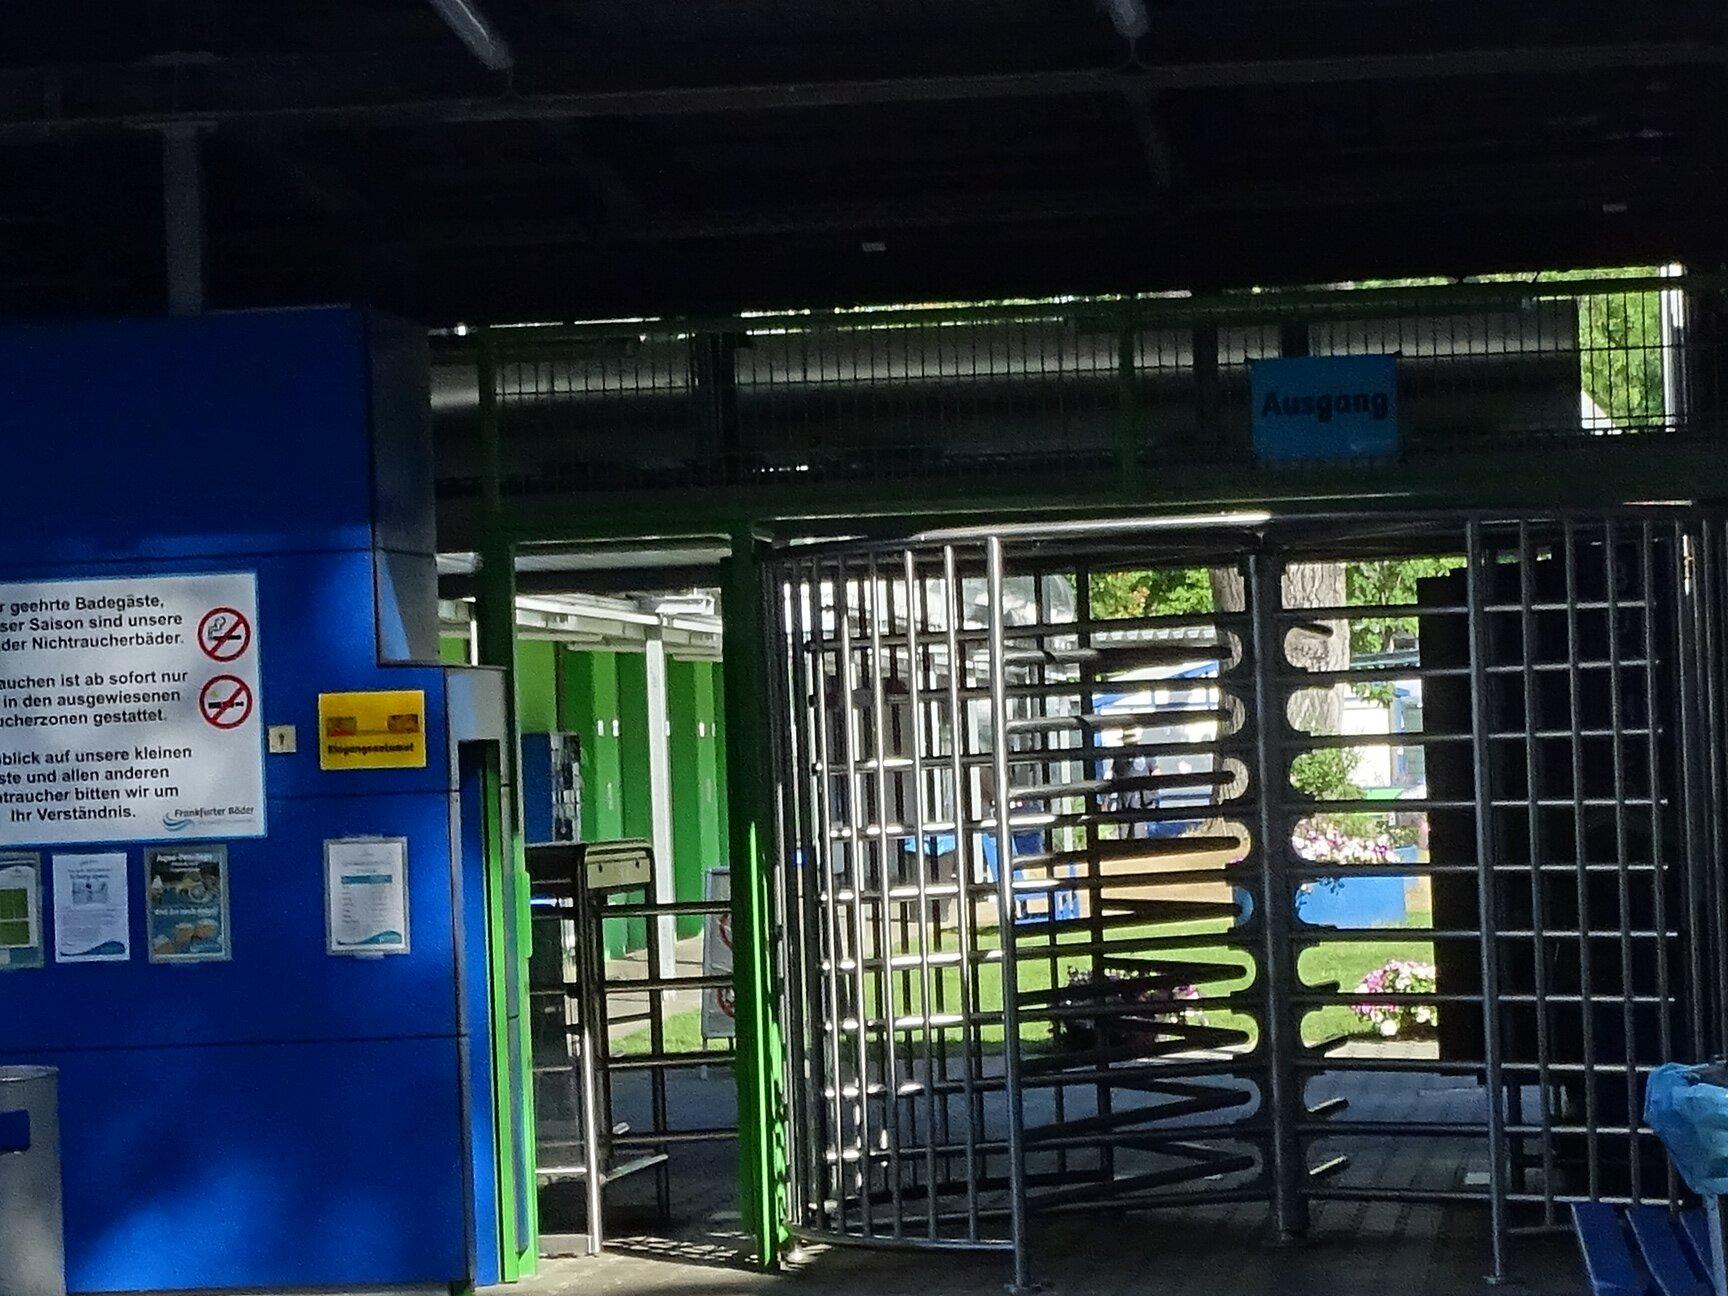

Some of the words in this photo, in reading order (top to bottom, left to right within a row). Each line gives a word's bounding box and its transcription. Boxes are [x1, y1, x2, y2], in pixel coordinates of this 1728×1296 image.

[1262, 391, 1388, 423] Ausgang
[10, 599, 70, 616] geehrte
[75, 595, 164, 612] Badegäste,
[30, 617, 83, 631] Saison
[89, 615, 123, 629] sind
[129, 614, 182, 627] unsere
[32, 632, 184, 651] Nichtraucherbäder.
[61, 674, 80, 687] ist
[85, 672, 104, 686] ab
[109, 671, 156, 685] sofort
[161, 671, 188, 683] nur
[3, 695, 17, 708] in
[22, 694, 52, 708] den
[57, 690, 181, 708] ausgewiesenen
[93, 709, 167, 727] gestattet.
[45, 750, 70, 764] auf
[76, 749, 130, 762] unsere
[135, 746, 192, 760] kleinen
[26, 769, 57, 784] und
[62, 769, 99, 782] allen
[105, 766, 169, 780] anderen
[75, 787, 120, 800] bitten
[125, 785, 150, 798] wir
[154, 786, 179, 798] um
[11, 809, 32, 822] Ihr
[37, 806, 136, 821] Verständnis.
[175, 807, 225, 818] Frankfurter
